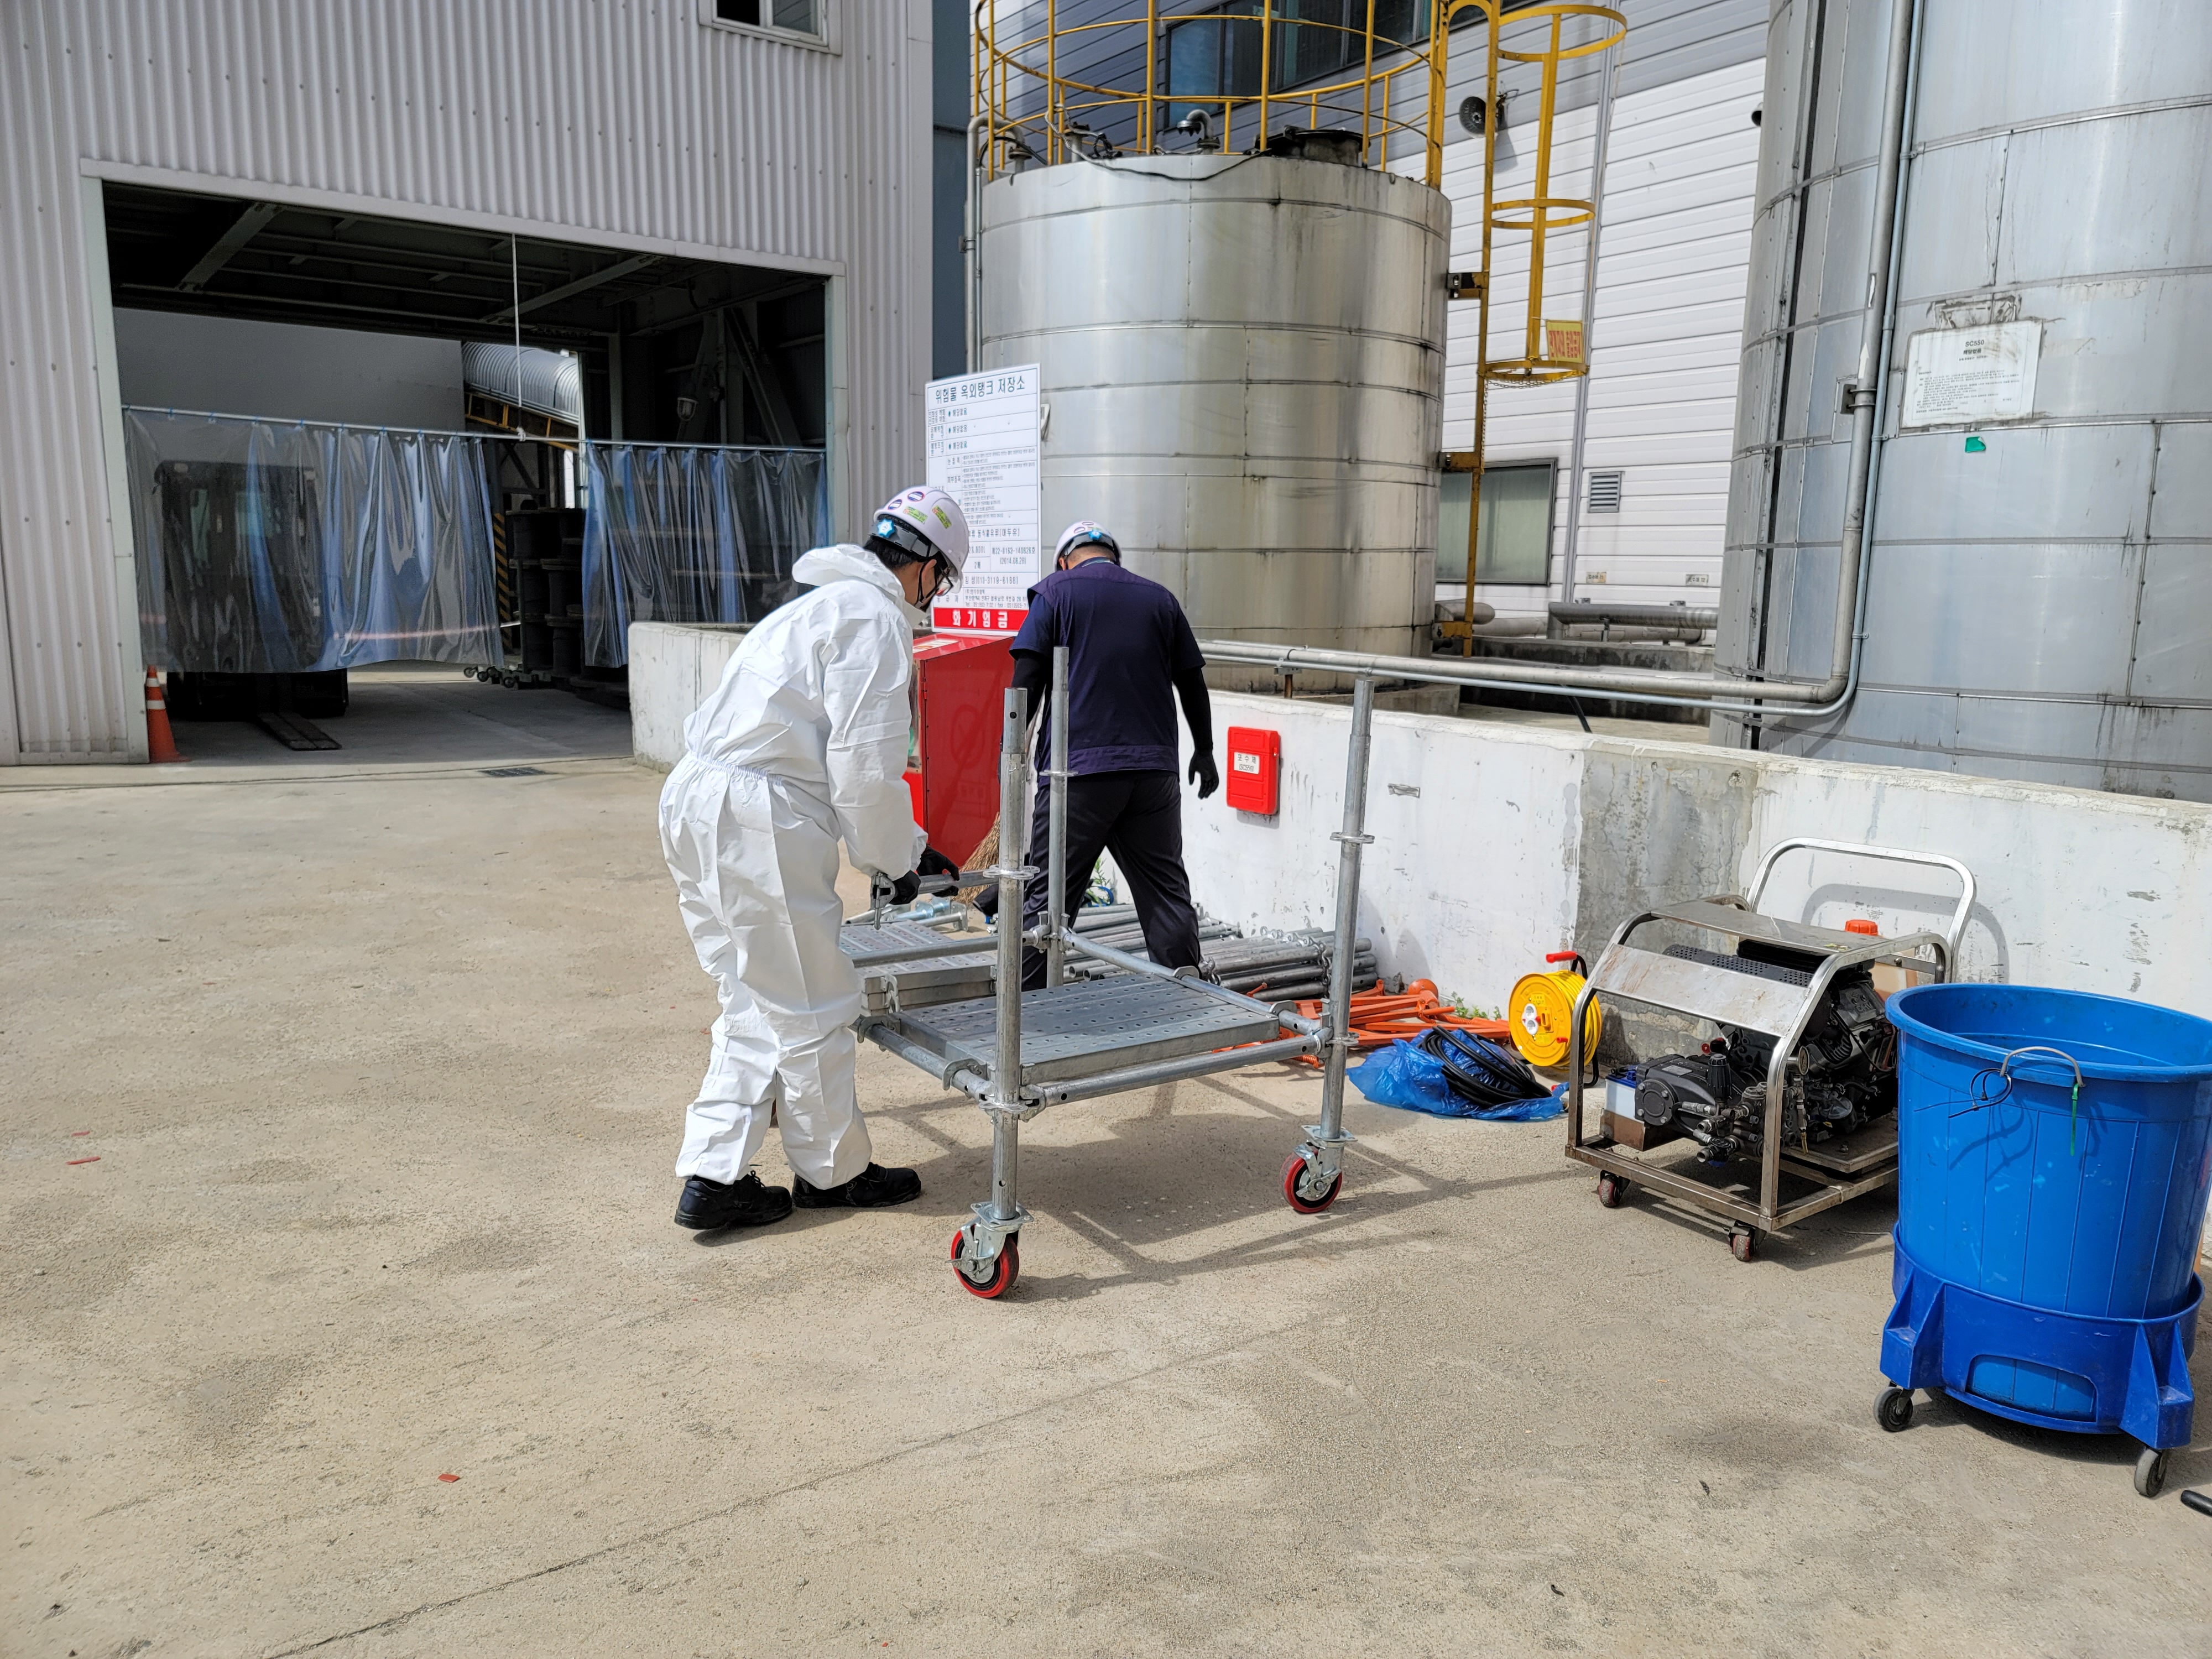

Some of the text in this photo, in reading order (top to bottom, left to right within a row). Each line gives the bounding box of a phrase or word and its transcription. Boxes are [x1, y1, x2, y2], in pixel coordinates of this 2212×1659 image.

[936, 375, 1025, 404] 위험물 옥외탱크 저장소
[952, 609, 1008, 629] 화기엄금
